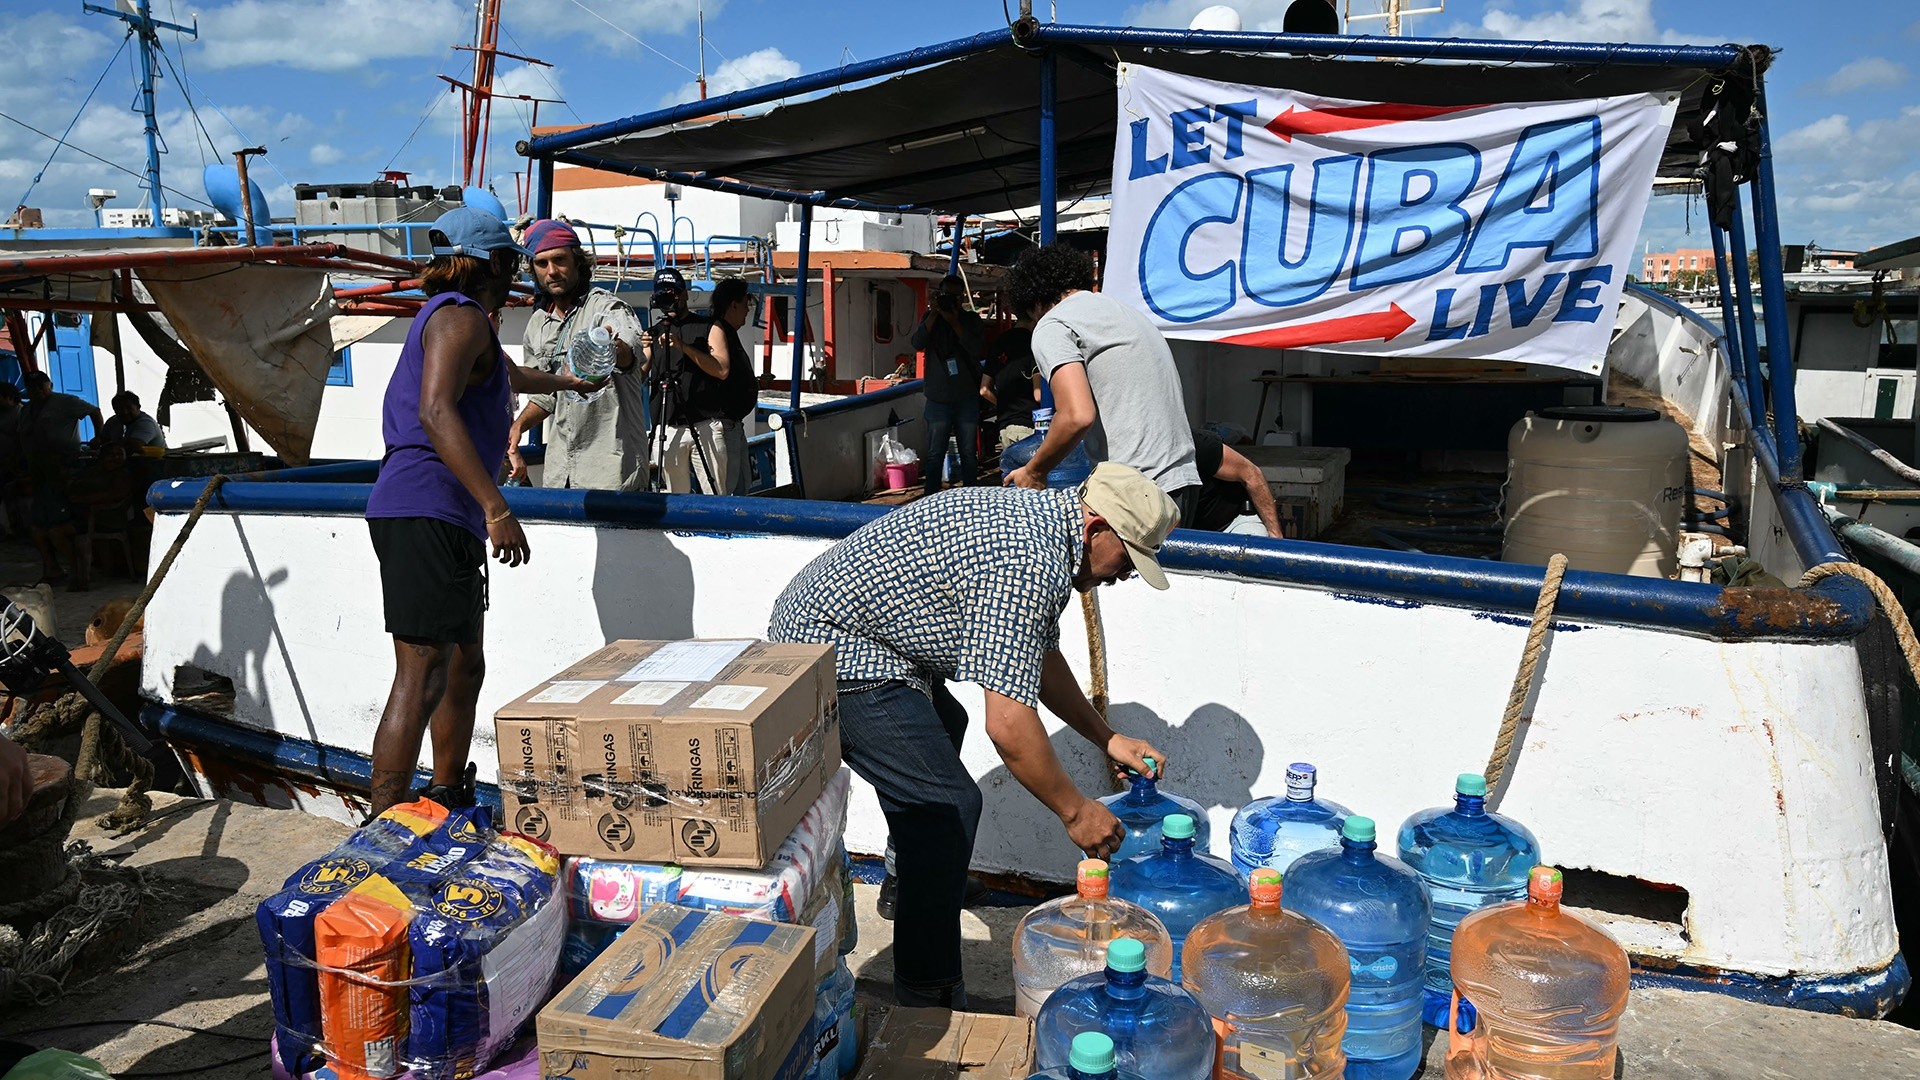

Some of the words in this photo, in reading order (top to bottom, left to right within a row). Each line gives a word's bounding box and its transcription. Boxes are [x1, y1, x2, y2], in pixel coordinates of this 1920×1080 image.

[1128, 100, 1258, 181] LET
[1138, 115, 1602, 323] CUBA
[1426, 264, 1613, 341] LIVE
[406, 852, 439, 871] SAN
[447, 884, 483, 904] 5
[1371, 962, 1396, 972] cristal
[813, 1022, 839, 1057] RKL
